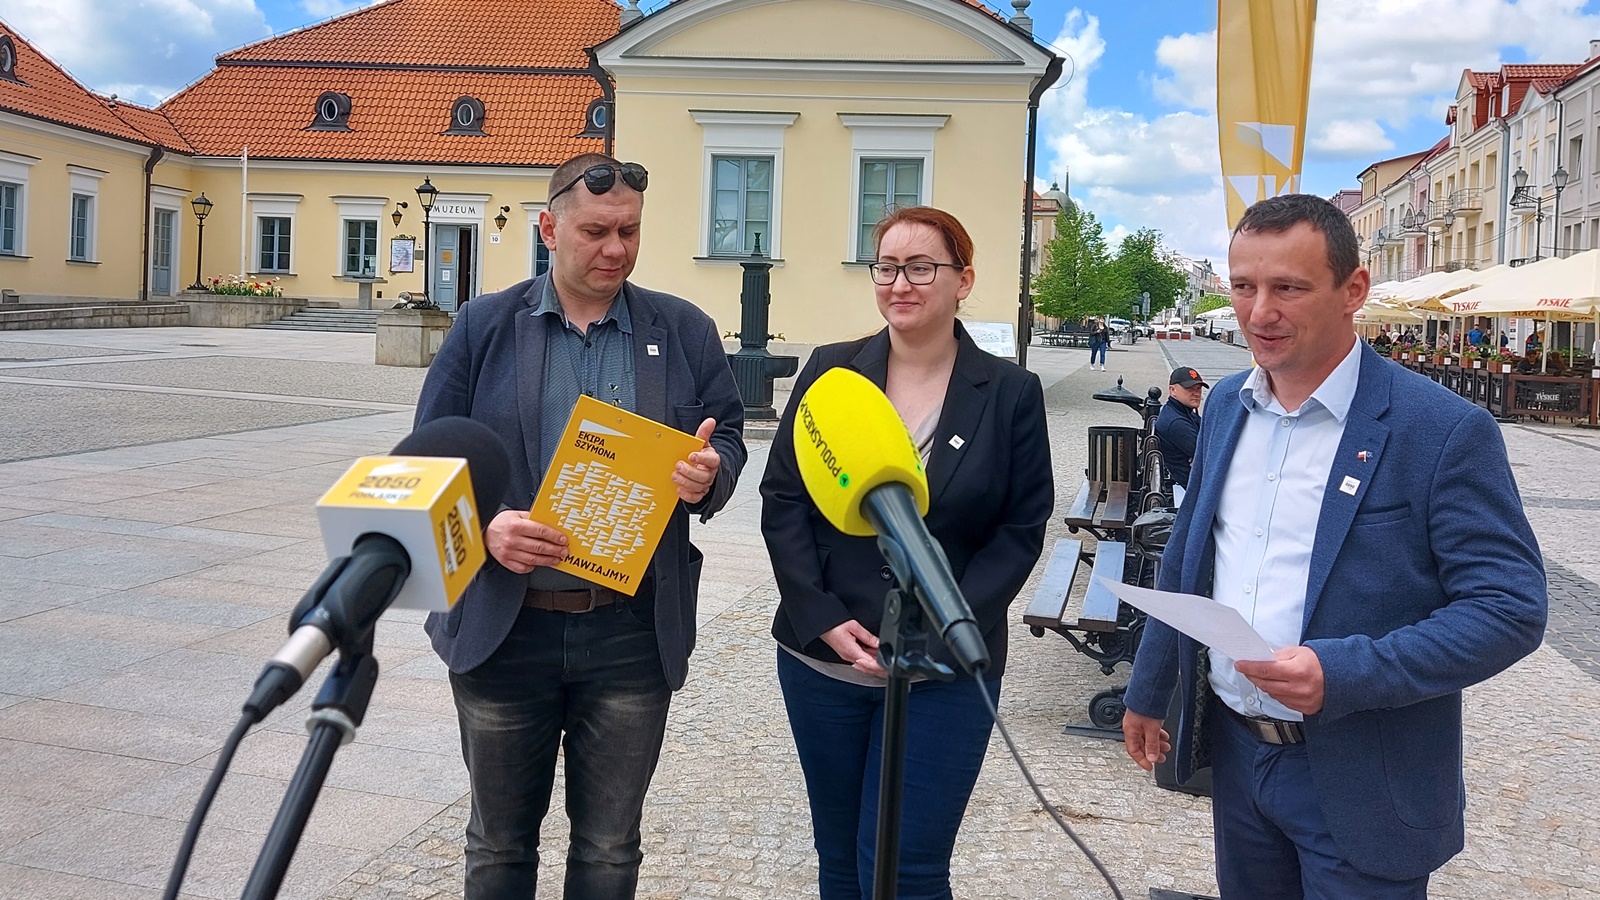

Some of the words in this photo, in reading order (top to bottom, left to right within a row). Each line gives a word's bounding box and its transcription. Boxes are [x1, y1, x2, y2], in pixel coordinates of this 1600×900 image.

[432, 205, 476, 214] MUZEUM
[1453, 301, 1481, 312] TYSKIE
[1537, 298, 1573, 308] TYSKIE
[1535, 392, 1560, 401] TYSKIE
[578, 430, 605, 447] EKIPA
[574, 439, 616, 461] SZYMONA
[357, 475, 422, 489] 2050
[446, 505, 467, 567] 2050
[560, 553, 630, 584] MAWIAJMY!
